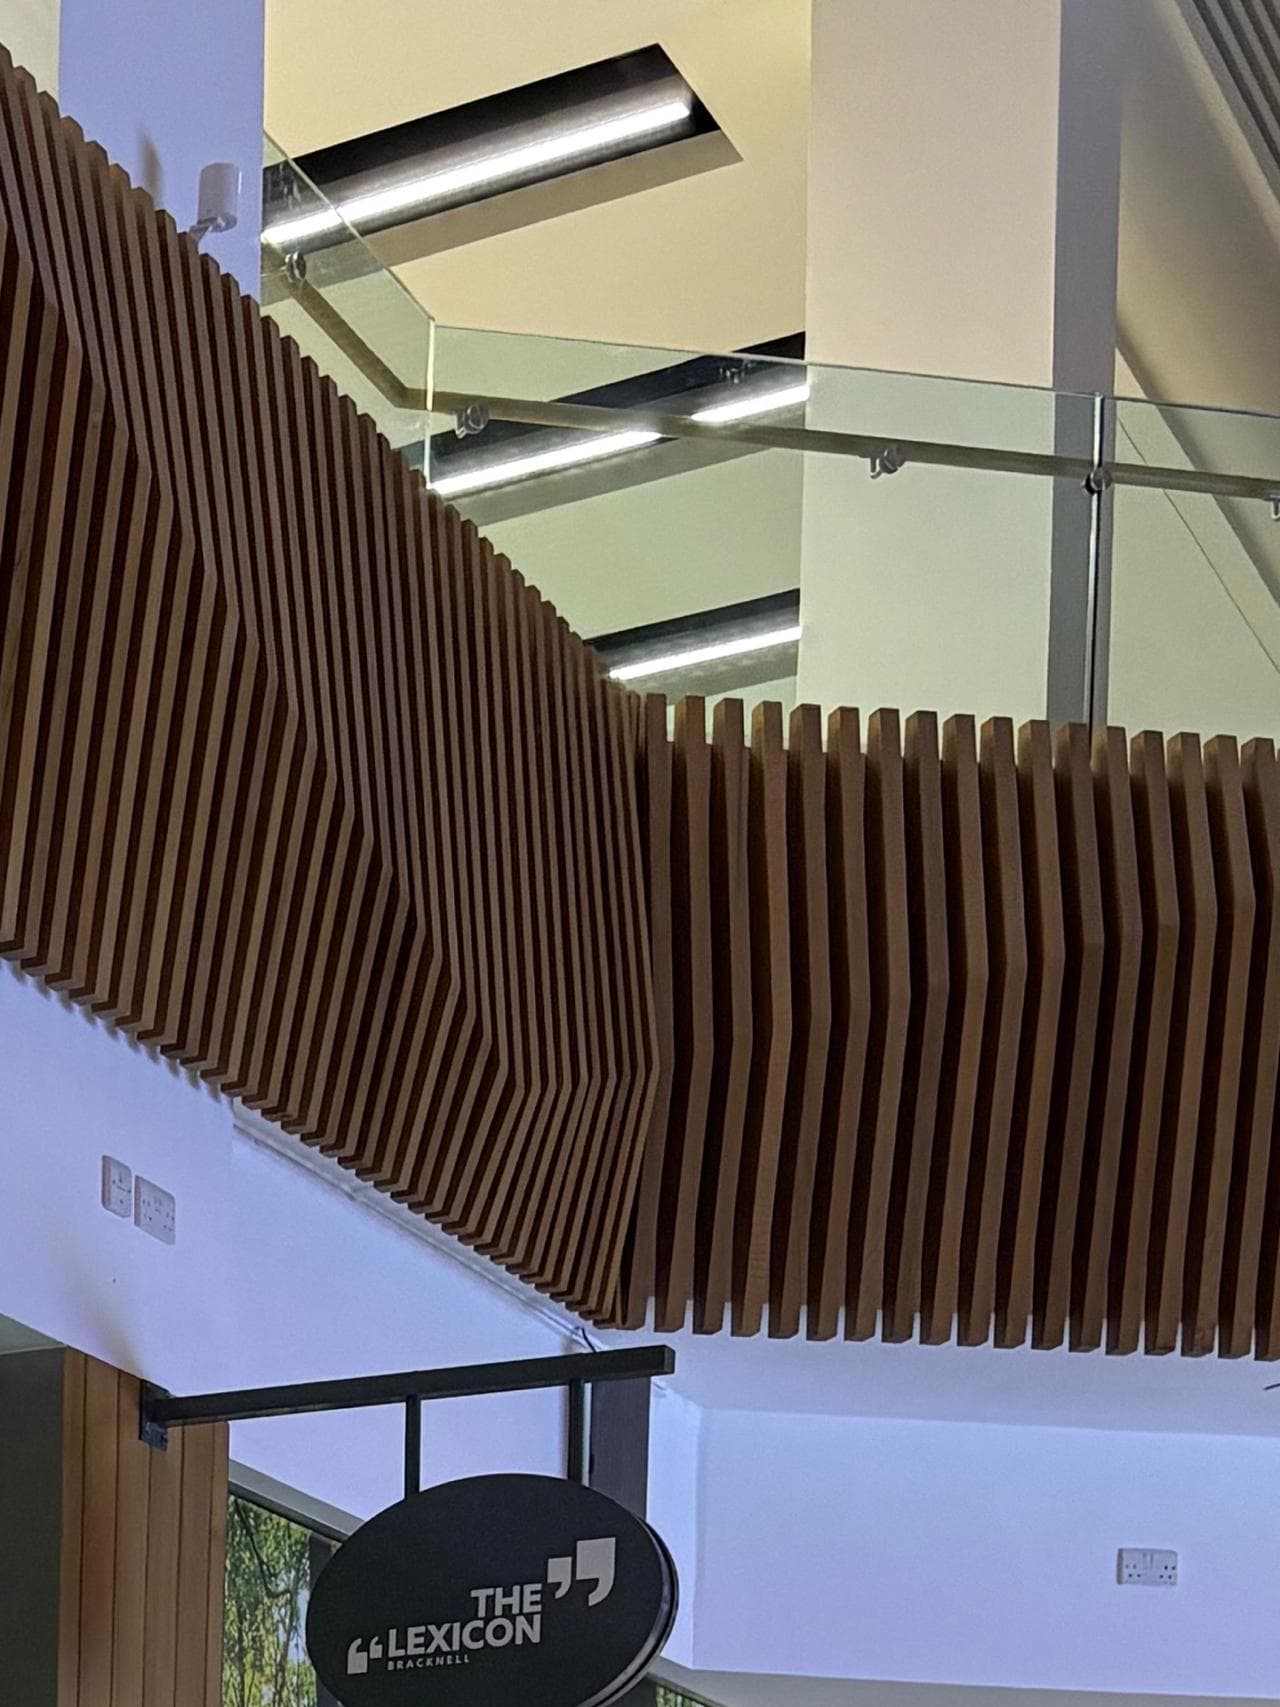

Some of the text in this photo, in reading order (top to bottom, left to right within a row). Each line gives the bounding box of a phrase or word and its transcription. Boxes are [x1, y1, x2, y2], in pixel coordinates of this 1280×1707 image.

[471, 1583, 542, 1618] THE
[388, 1614, 541, 1658] LEXICON
[387, 1654, 470, 1671] BRACKNELL
